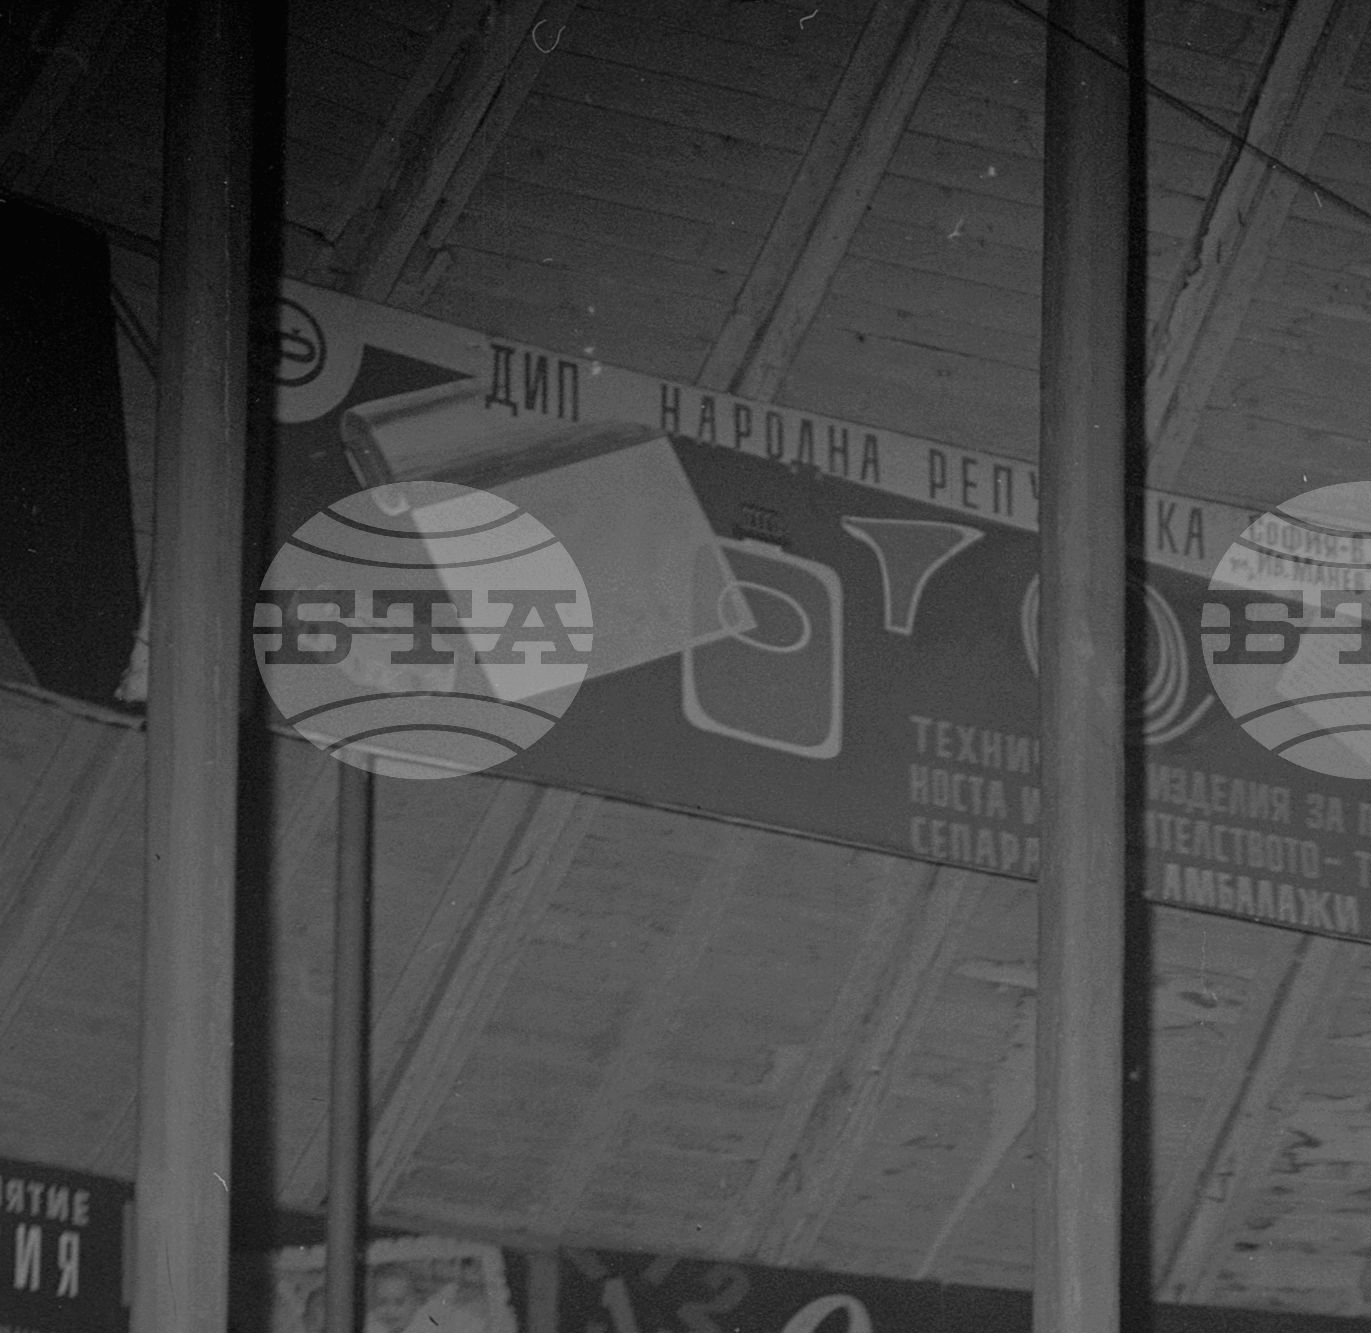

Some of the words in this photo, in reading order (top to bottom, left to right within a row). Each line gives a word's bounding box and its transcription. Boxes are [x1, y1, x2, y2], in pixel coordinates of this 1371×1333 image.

[485, 343, 580, 423] ДИП
[660, 384, 880, 484] НАРОДНА
[908, 714, 1040, 774] ТЕХНИ
[1304, 793, 1346, 834] ЗА
[909, 815, 1041, 875] СЕПАРА
[1162, 862, 1361, 935] АМБАЛАЖИ
[0, 1178, 91, 1228] ЯТИЕ
